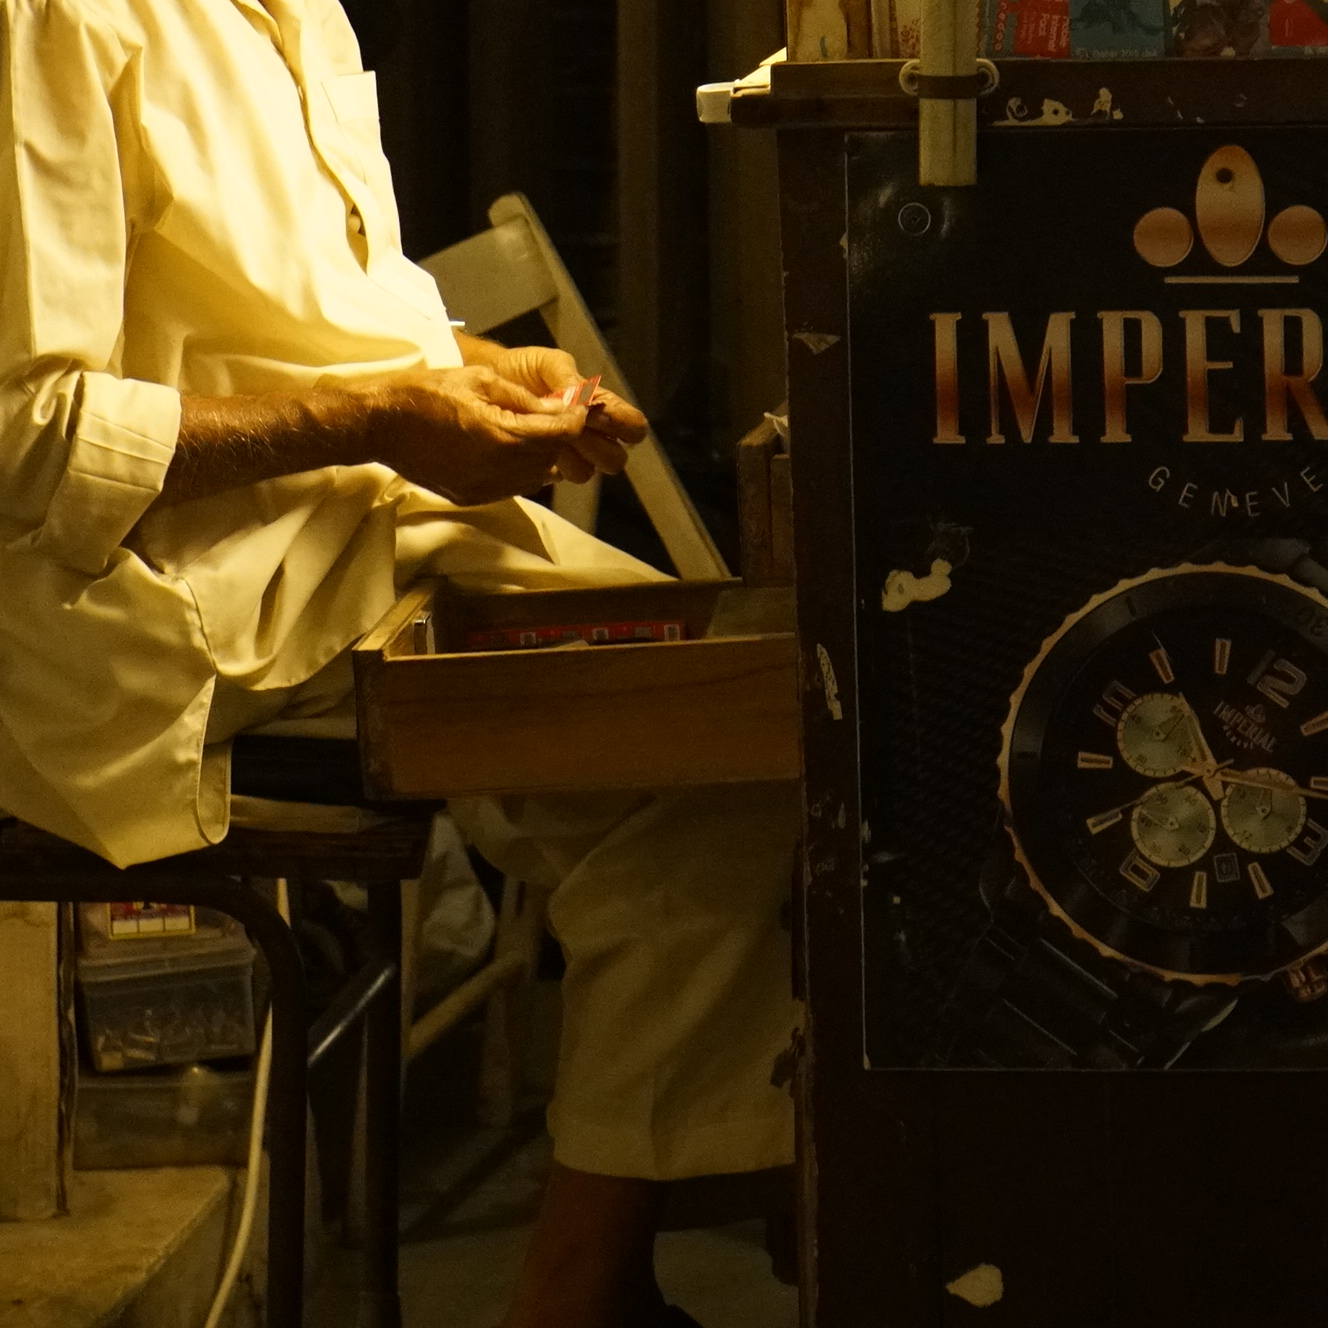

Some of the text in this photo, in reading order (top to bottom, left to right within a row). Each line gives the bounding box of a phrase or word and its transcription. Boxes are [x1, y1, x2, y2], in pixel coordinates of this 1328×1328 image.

[1039, 13, 1050, 36] Pack
[1147, 464, 1325, 519] GENEVE
[1246, 649, 1307, 709] 12
[1213, 700, 1277, 753] IMPERIAL
